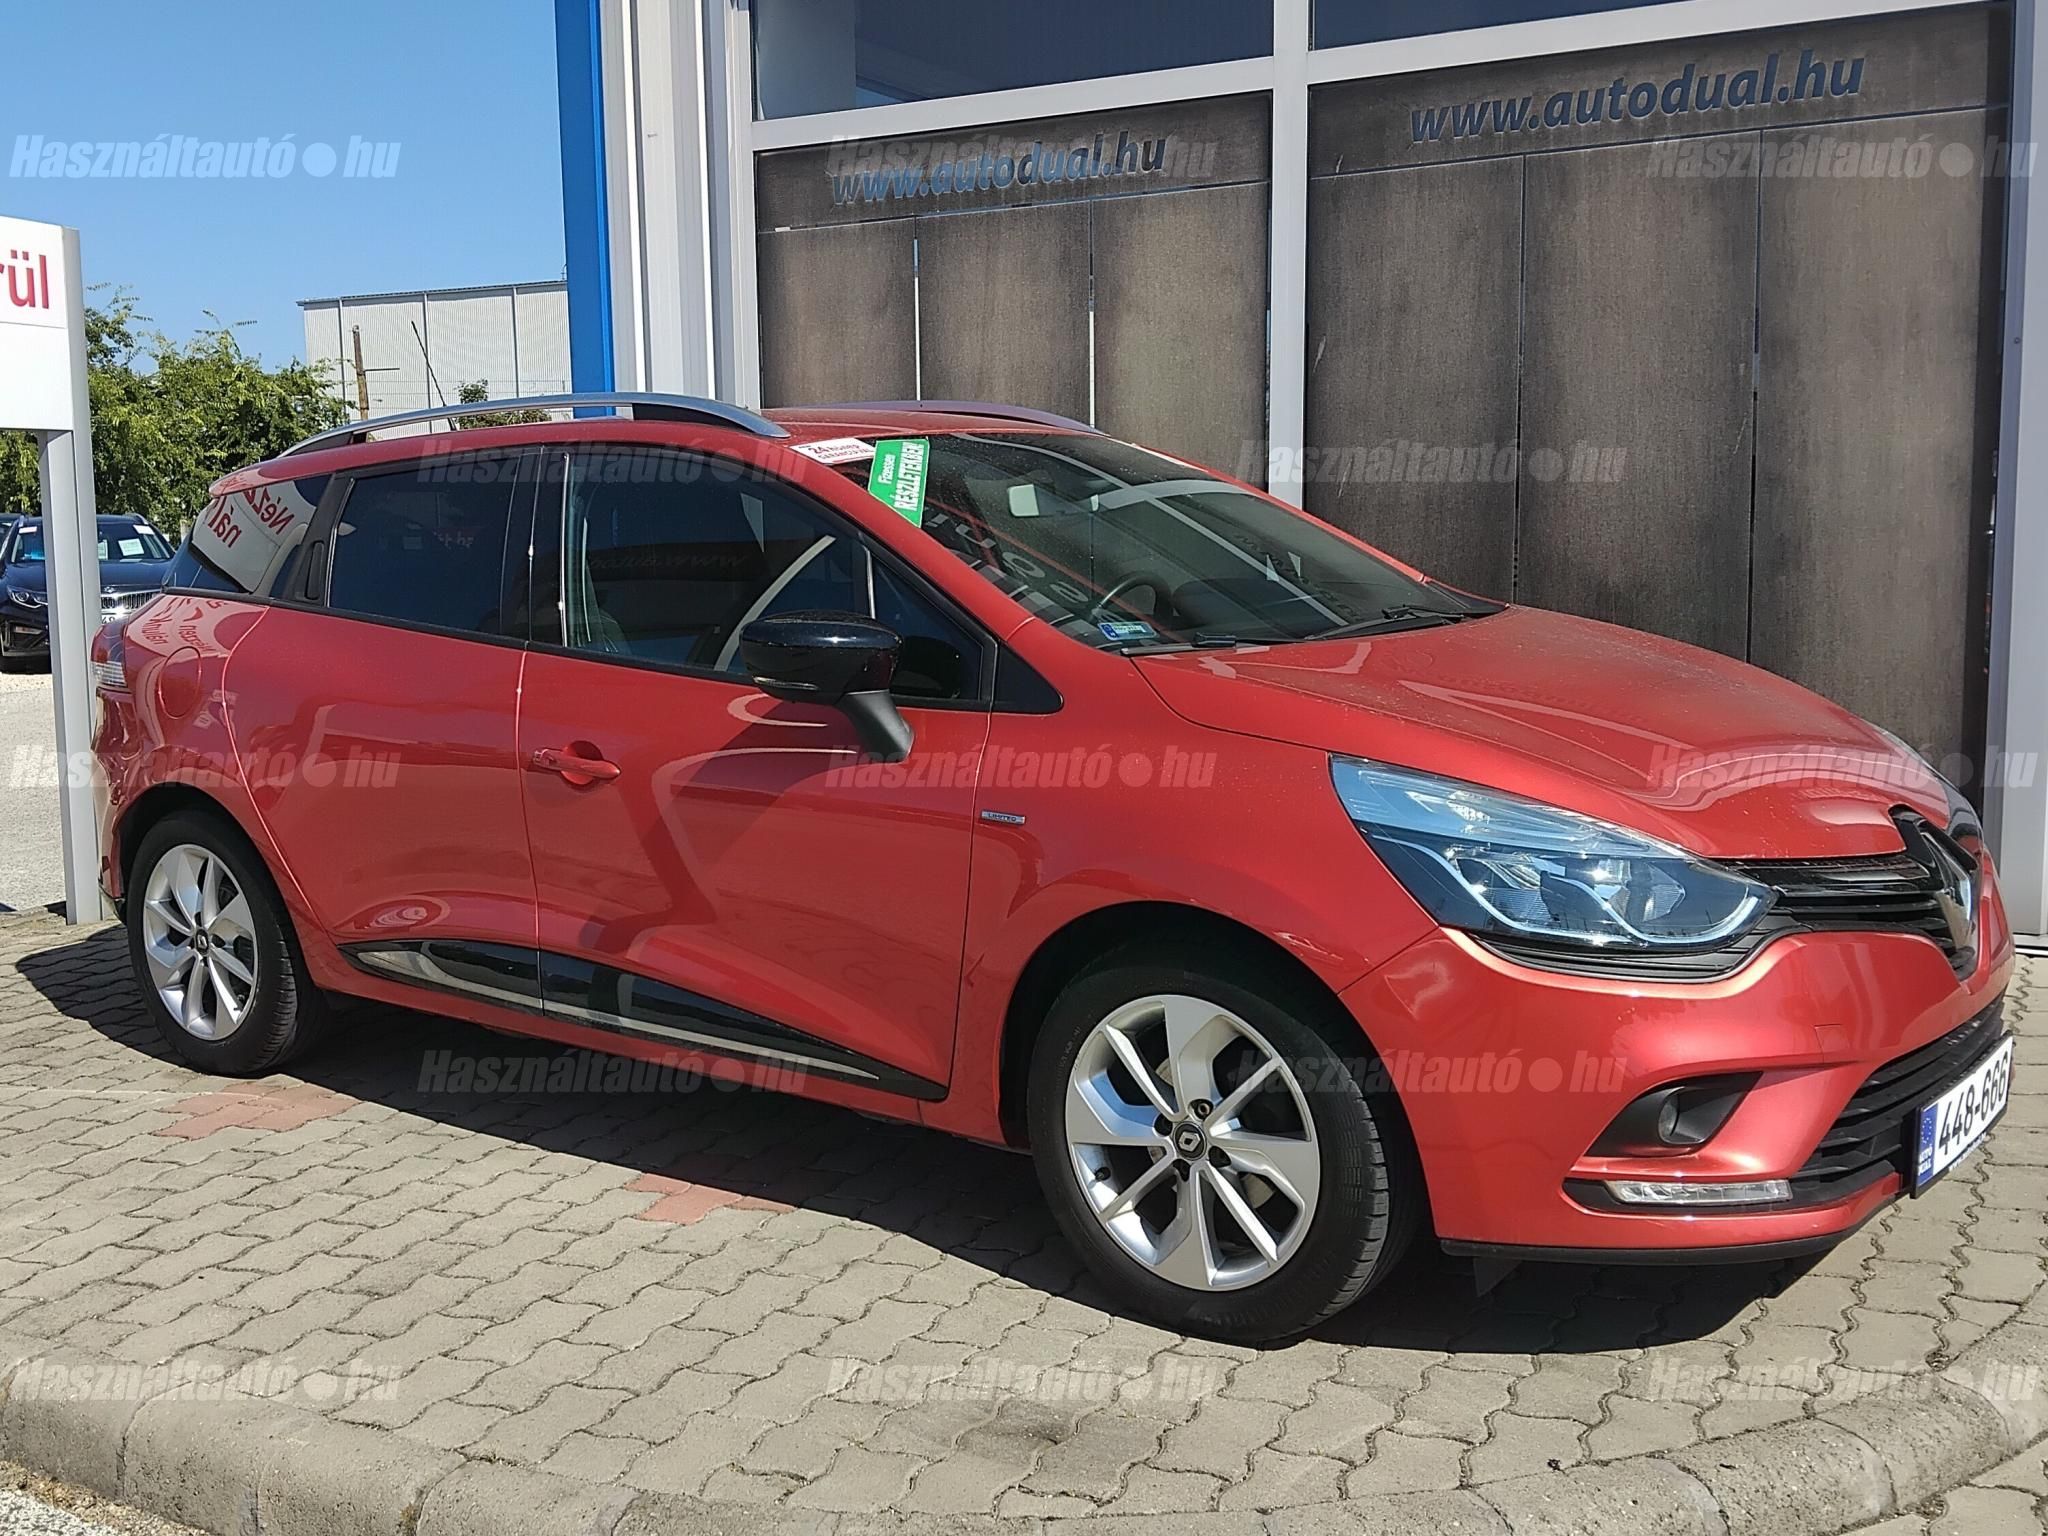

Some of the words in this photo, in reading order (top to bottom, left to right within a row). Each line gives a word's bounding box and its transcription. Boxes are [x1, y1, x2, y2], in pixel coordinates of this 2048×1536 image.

[1411, 50, 1865, 143] www.autodual.hu
[831, 130, 1167, 206] www.autodual.hu
[0, 249, 49, 309] ül
[1939, 1051, 2008, 1155] 448-666
